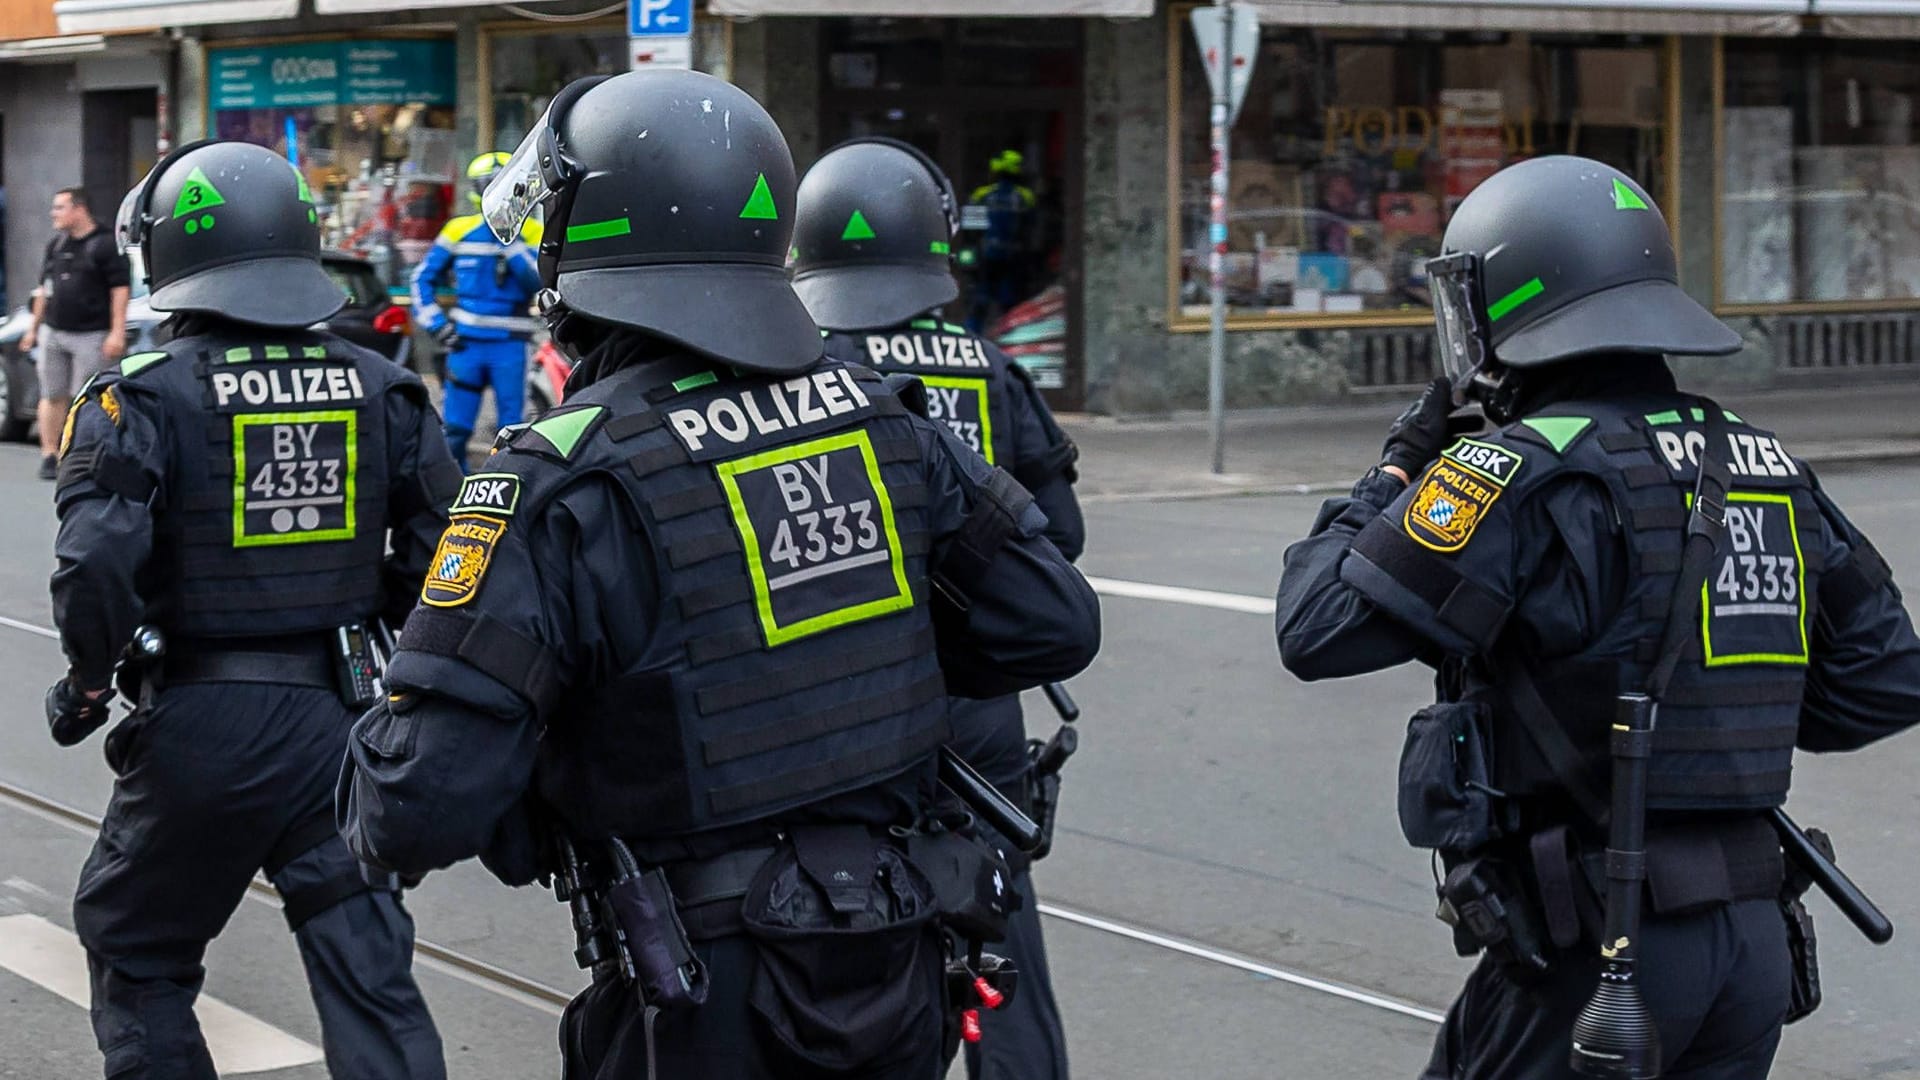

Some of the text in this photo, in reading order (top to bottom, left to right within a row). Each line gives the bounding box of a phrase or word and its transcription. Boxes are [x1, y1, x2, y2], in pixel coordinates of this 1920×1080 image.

[639, 0, 672, 28] P
[1322, 105, 1537, 155] PODM
[188, 186, 203, 205] 3
[867, 335, 990, 368] POLIZEI
[212, 368, 364, 406] POLIZEI
[668, 368, 870, 451] POLIZEI
[273, 424, 319, 460] BY
[1457, 444, 1510, 475] USK
[1655, 431, 1799, 476] POIZEI
[251, 459, 340, 498] 4333
[463, 480, 510, 506] USK
[772, 455, 833, 513] BY
[1434, 466, 1492, 504] POLIZEI
[769, 499, 879, 568] 4333
[1725, 506, 1766, 553] BY
[1715, 555, 1798, 601] 4333
